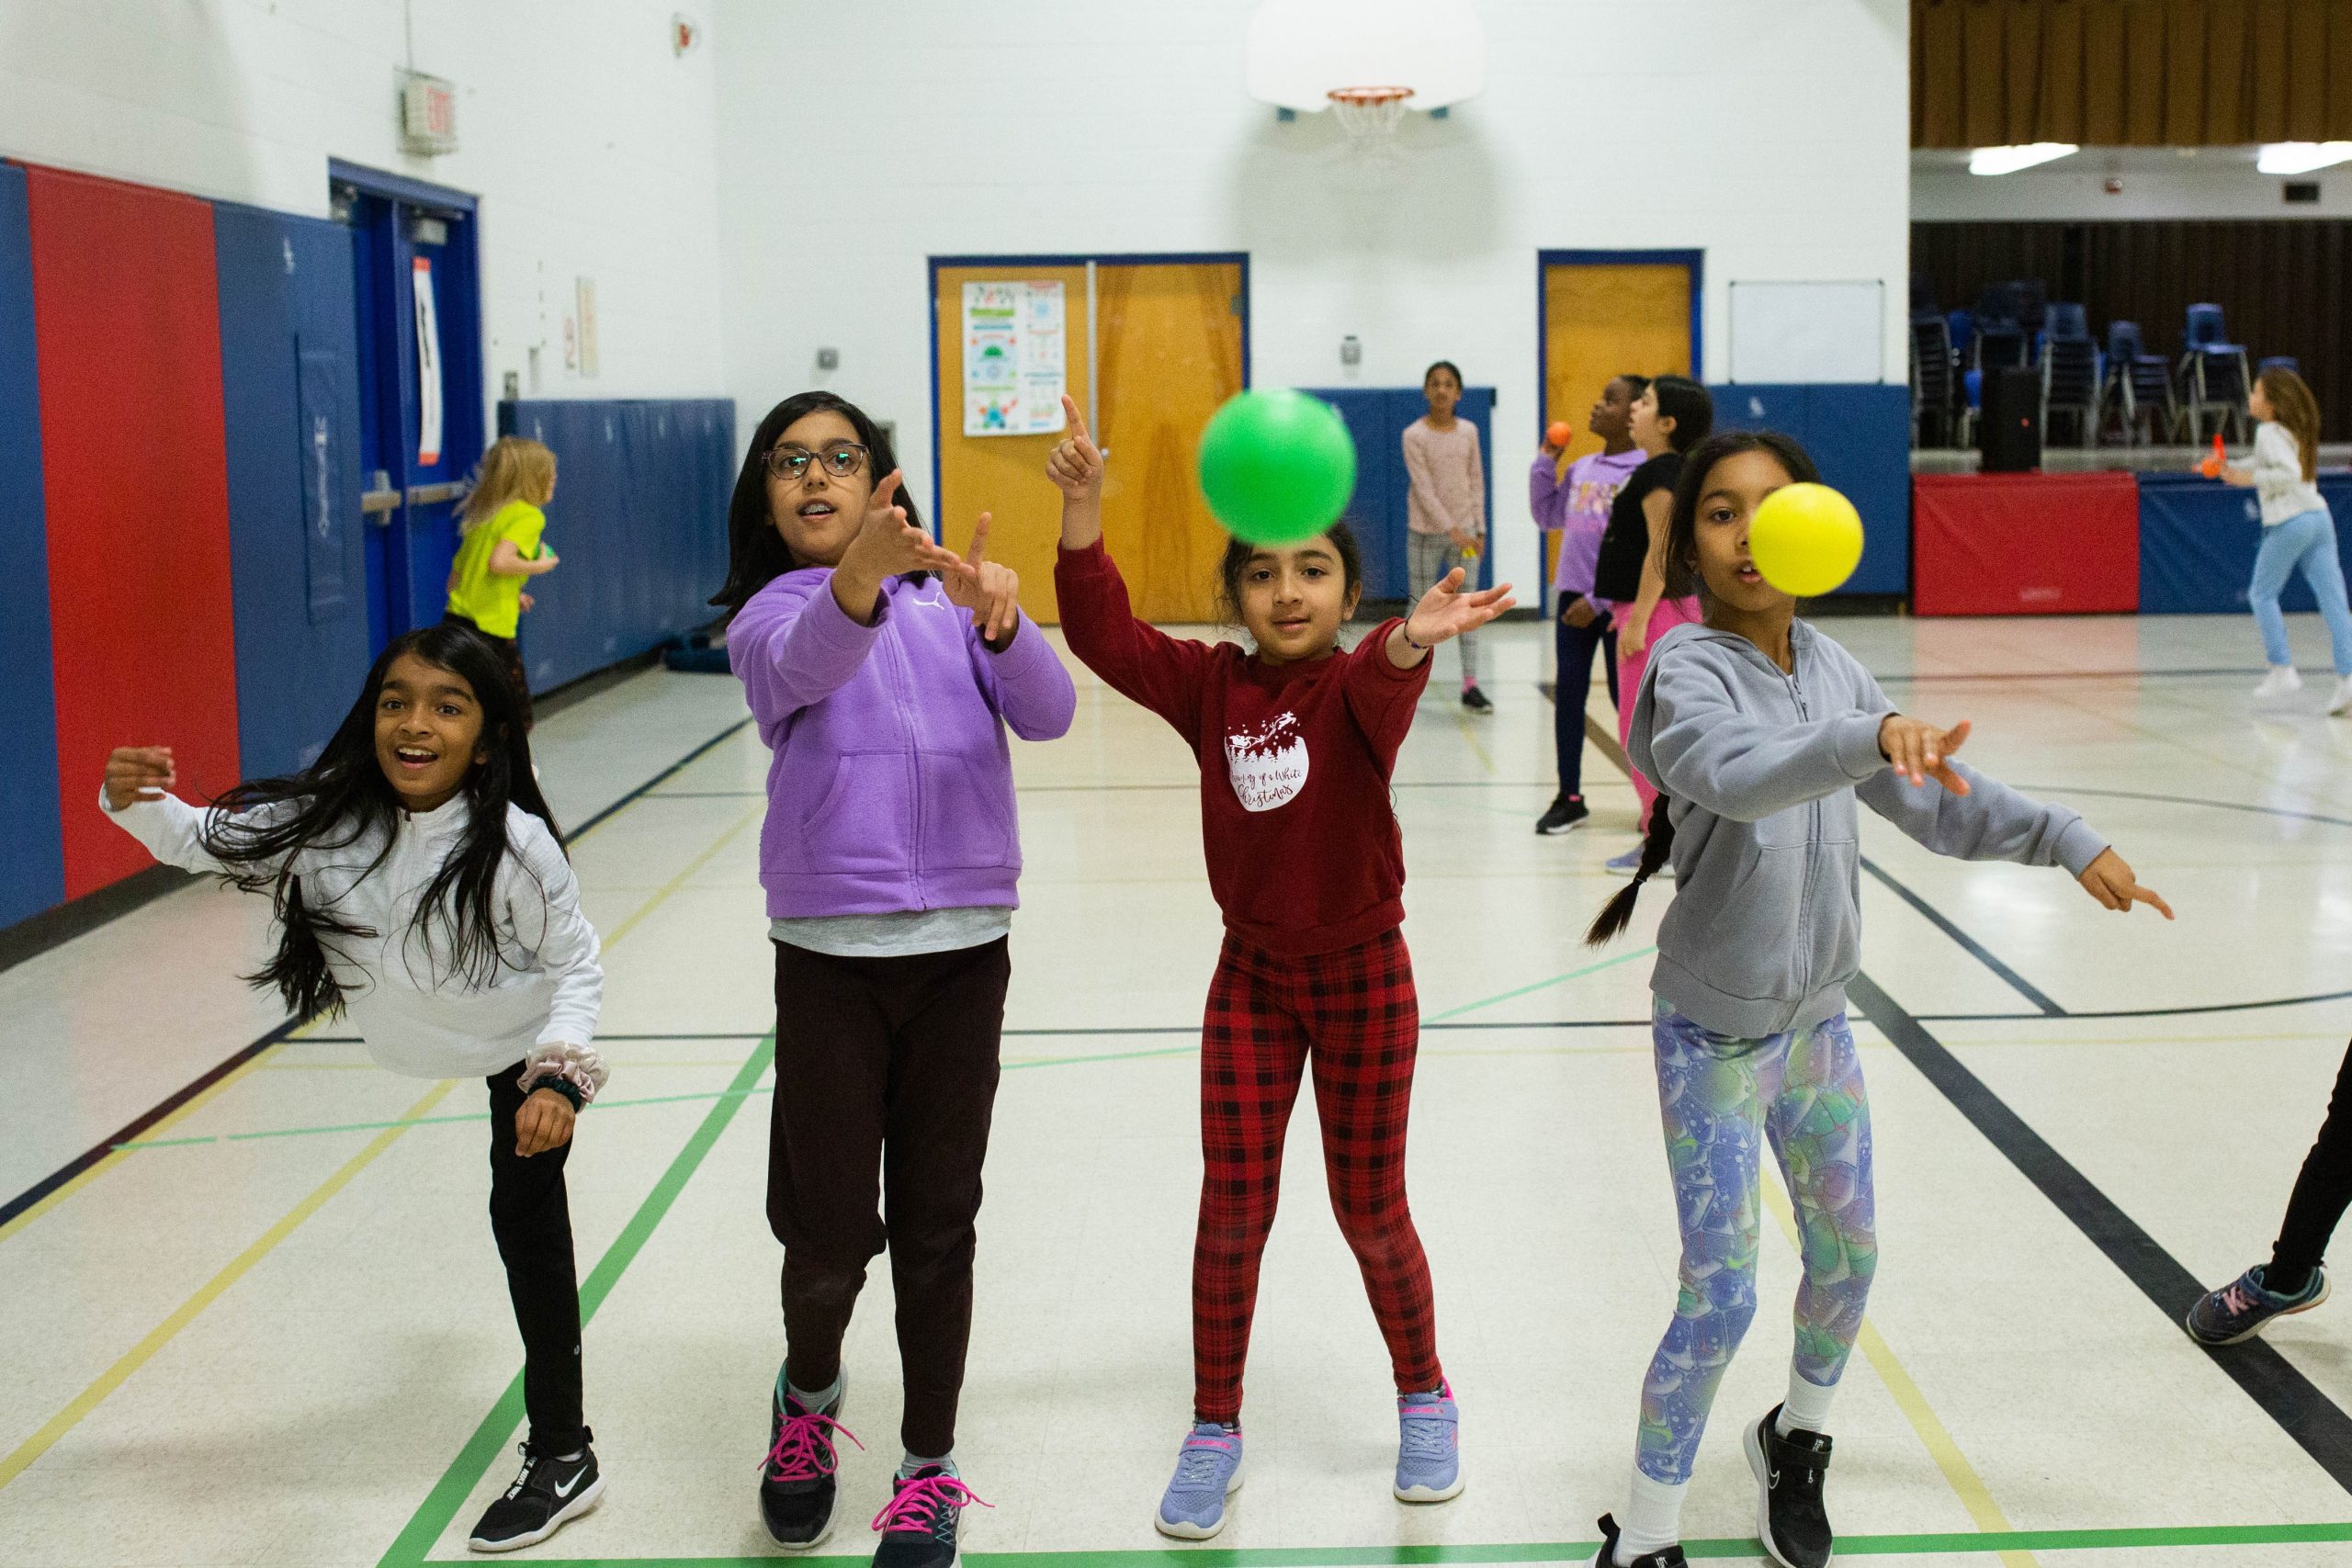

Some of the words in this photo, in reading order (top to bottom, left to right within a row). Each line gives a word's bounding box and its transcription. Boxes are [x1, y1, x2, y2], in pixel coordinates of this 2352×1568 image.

[1275, 767, 1302, 782] White
[1237, 784, 1294, 807] Christmas
[516, 1468, 530, 1485] NIKE
[506, 1485, 523, 1501] NIKE
